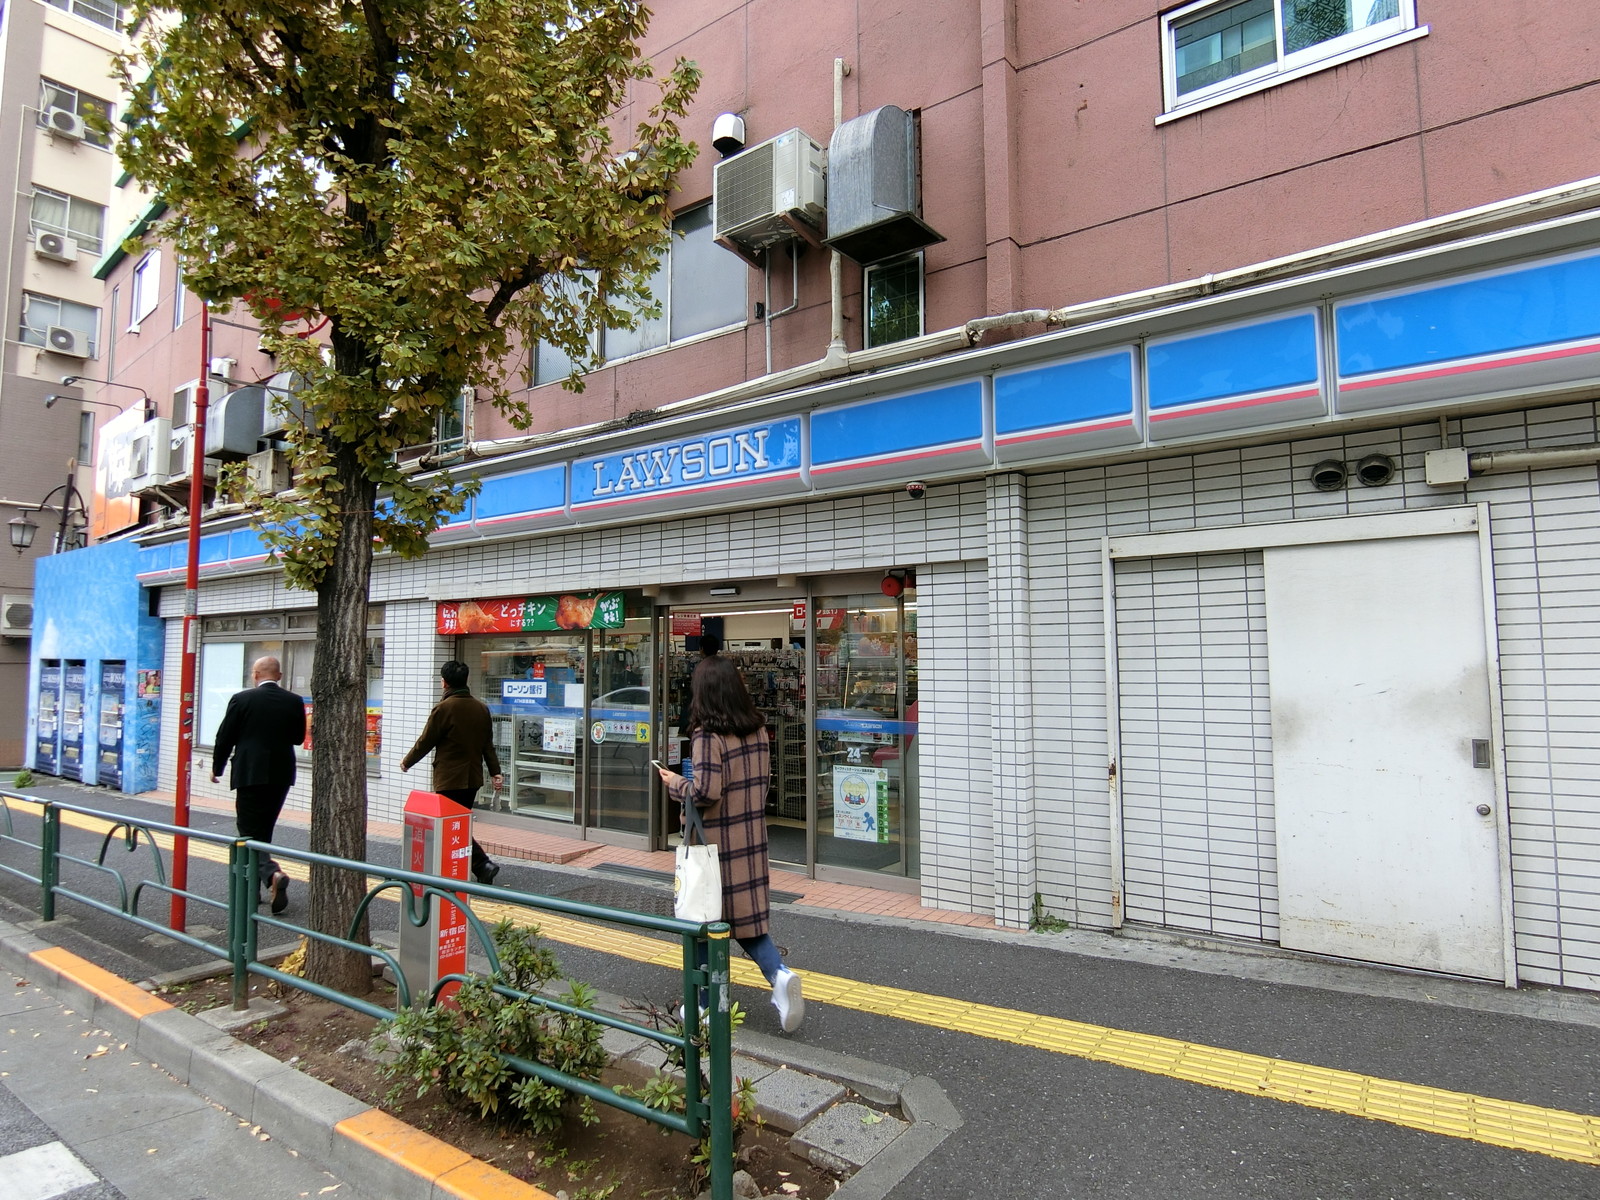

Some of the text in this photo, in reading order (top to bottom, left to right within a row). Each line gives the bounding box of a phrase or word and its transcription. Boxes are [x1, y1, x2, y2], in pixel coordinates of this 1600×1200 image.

[592, 428, 769, 496] LAWSON
[500, 602, 546, 618] どっチキン
[510, 618, 535, 628] にする??
[507, 684, 543, 695] ローソン銀行
[847, 747, 861, 759] 24
[451, 820, 461, 860] 消火器
[439, 924, 466, 938] 新宿区
